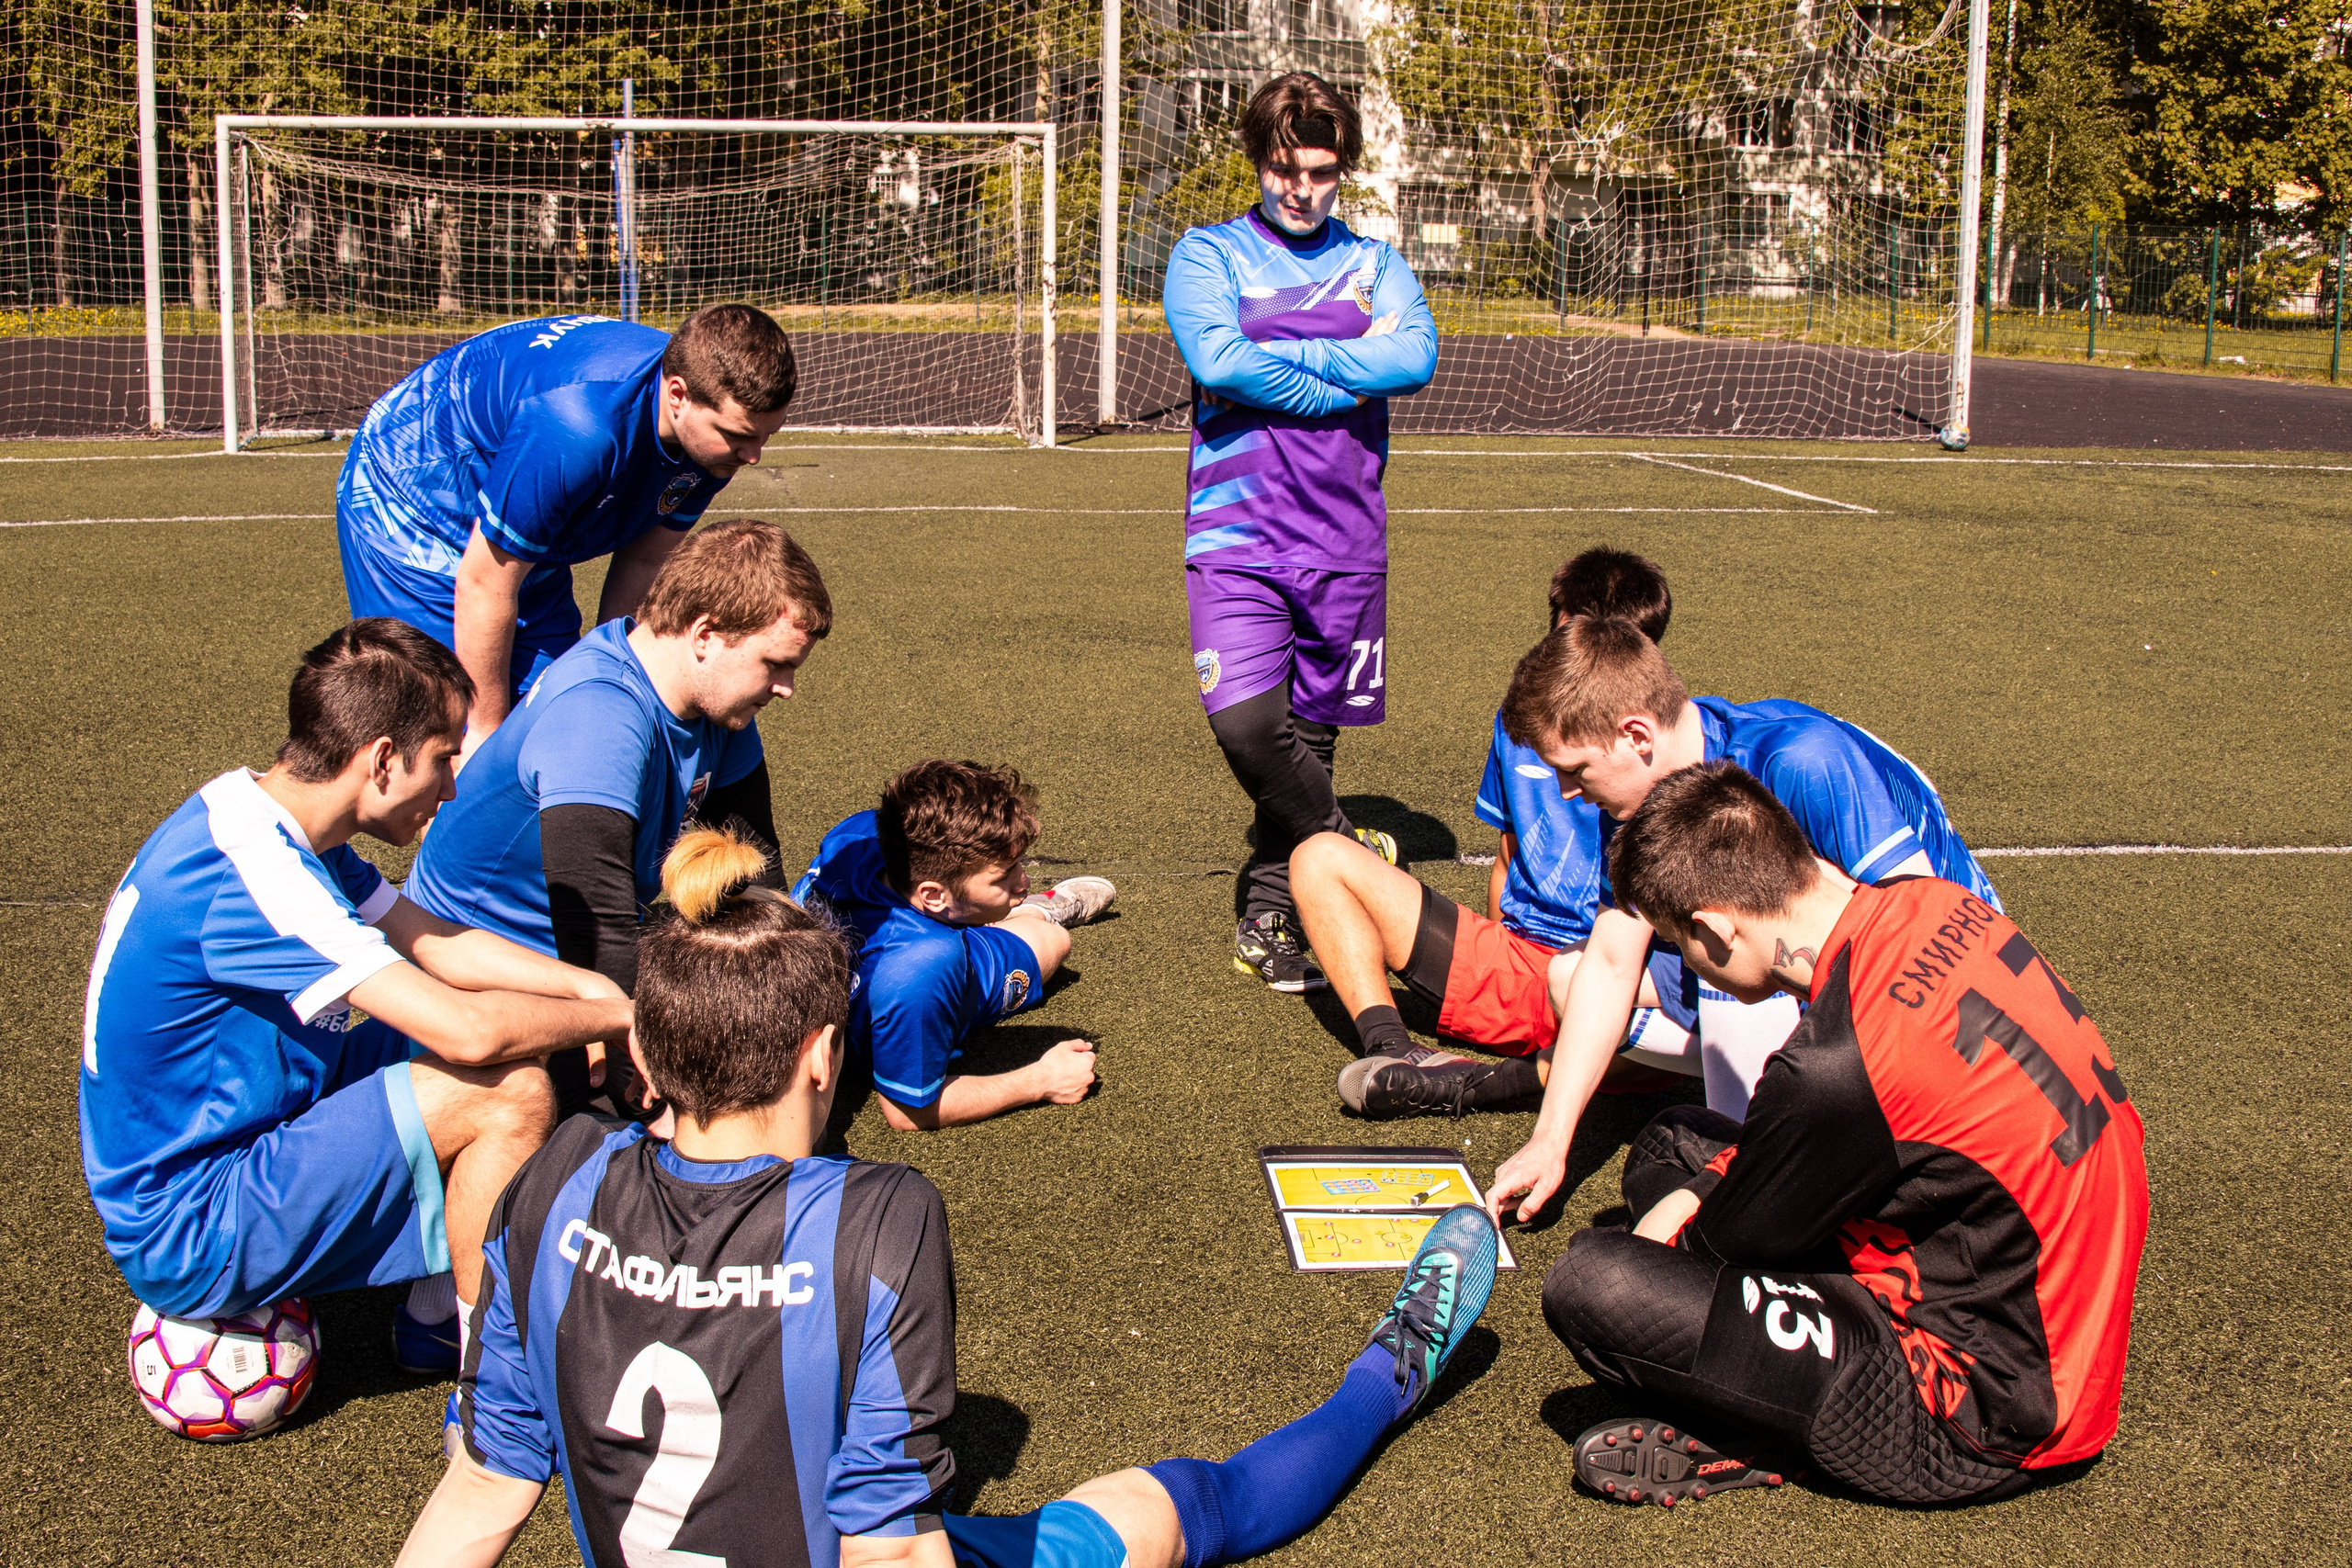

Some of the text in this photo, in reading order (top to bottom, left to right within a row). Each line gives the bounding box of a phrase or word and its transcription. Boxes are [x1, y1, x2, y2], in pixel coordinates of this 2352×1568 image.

[1347, 637, 1384, 690] 71
[1889, 893, 2000, 1009] СМИРНО
[147, 1364, 156, 1375] 5
[605, 1340, 728, 1568] 2
